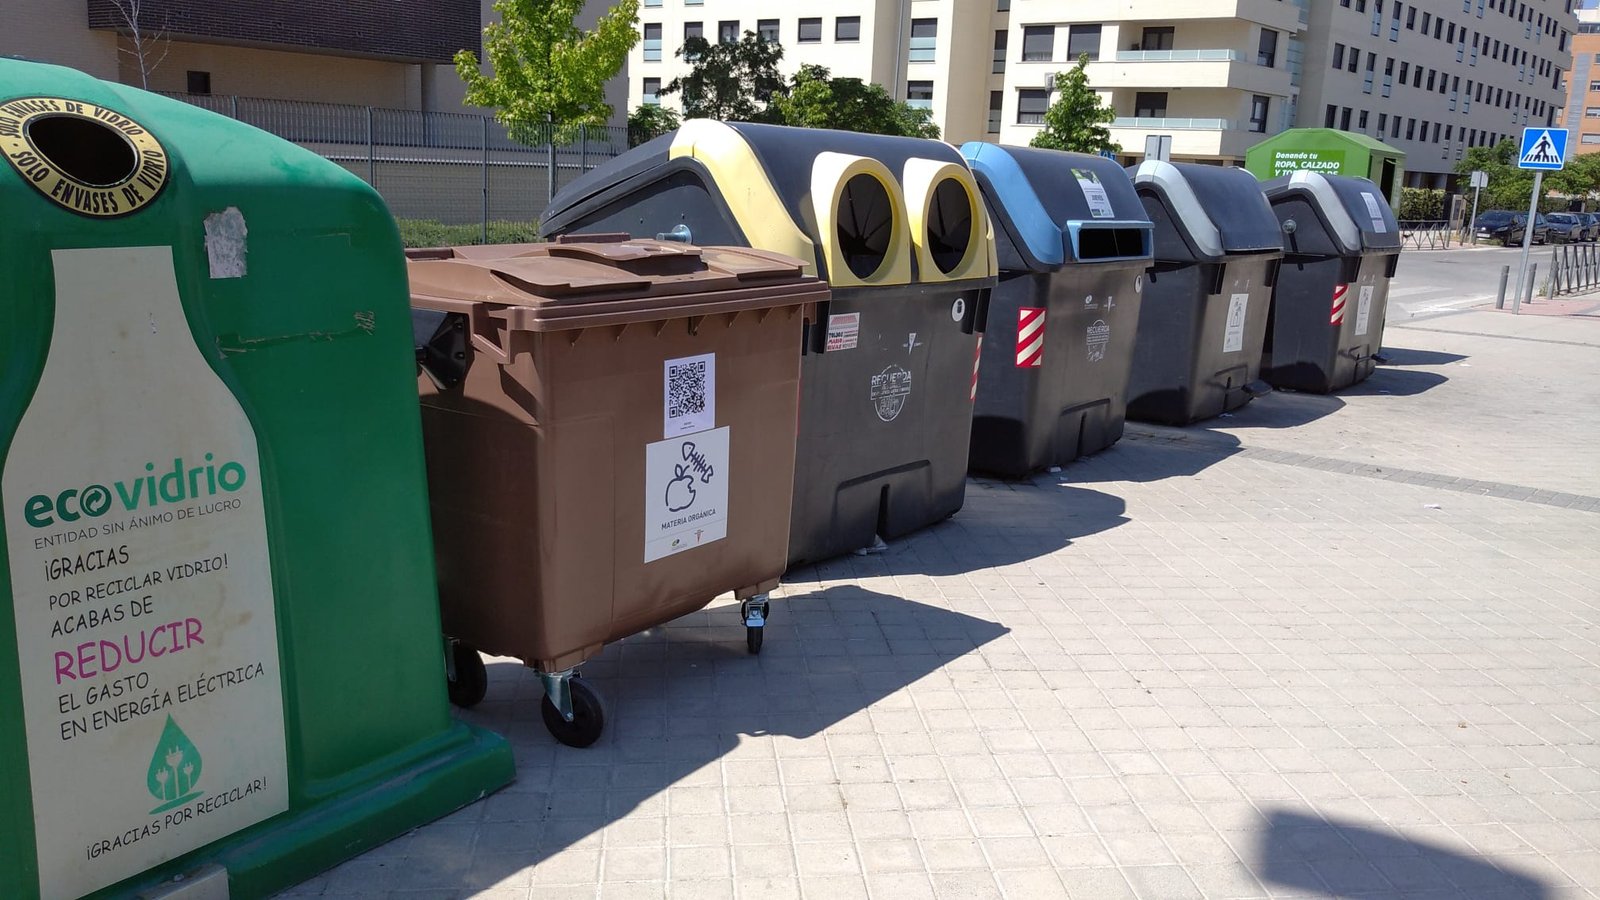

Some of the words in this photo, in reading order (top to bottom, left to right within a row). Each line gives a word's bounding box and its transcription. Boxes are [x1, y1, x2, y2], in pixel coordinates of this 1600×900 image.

[2, 100, 61, 118] ENVASES
[66, 101, 84, 115] DE
[94, 107, 144, 136] VIDRIO
[11, 151, 50, 183] SOLO
[51, 178, 119, 213] ENVASES
[121, 184, 145, 208] DE
[137, 150, 165, 191] VIDRIO
[1275, 160, 1299, 168] ROPA,
[1300, 161, 1340, 169] CALZADO
[24, 452, 246, 528] ecovidrio
[35, 527, 98, 550] ENTIDAD
[103, 522, 125, 536] SIN
[129, 511, 174, 530] ÁNIMO
[177, 507, 195, 521] DE
[198, 498, 242, 516] LUCRO
[661, 516, 687, 530] MATERIA
[688, 508, 716, 522] ORGÁNICA
[44, 545, 130, 582] ¡GRACIAS
[49, 590, 81, 611] POR
[86, 571, 163, 601] RECICLAR
[166, 553, 229, 581] VIDRIO!
[51, 604, 125, 638] ACABAS
[130, 595, 154, 614] DE
[54, 617, 205, 684] REDUCIR
[58, 694, 81, 713] EL
[86, 672, 149, 706] GASTO
[60, 717, 87, 740] EN
[92, 688, 173, 730] ENERGÍA
[178, 662, 265, 703] ELÉCTRICA
[86, 820, 161, 861] ¡GRACIAS
[165, 807, 193, 830] POR
[196, 776, 267, 817] RECICLAR!
